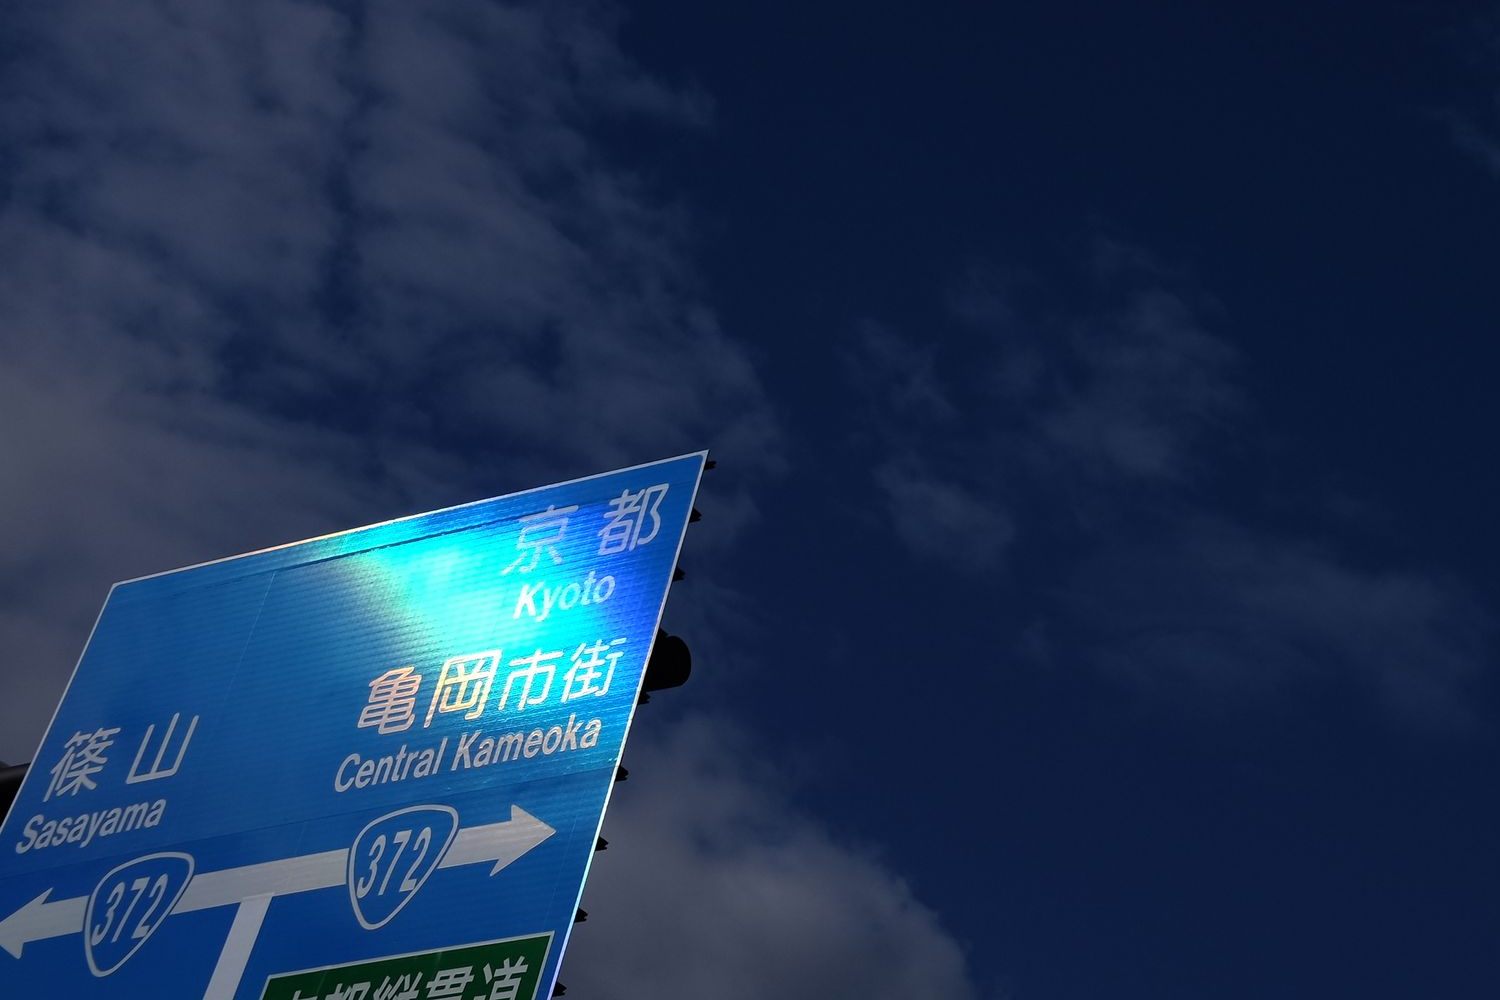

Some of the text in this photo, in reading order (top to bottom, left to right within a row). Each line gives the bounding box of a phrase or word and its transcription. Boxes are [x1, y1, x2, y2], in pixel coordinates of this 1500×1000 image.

[502, 483, 669, 575] 京都
[512, 570, 616, 622] Kyoto
[357, 637, 627, 735] 亀岡市街
[42, 712, 200, 803] 篠山
[334, 714, 602, 793] Central Kameoka
[15, 799, 167, 854] Sasayama
[356, 826, 432, 899] 372
[91, 873, 169, 946] 372
